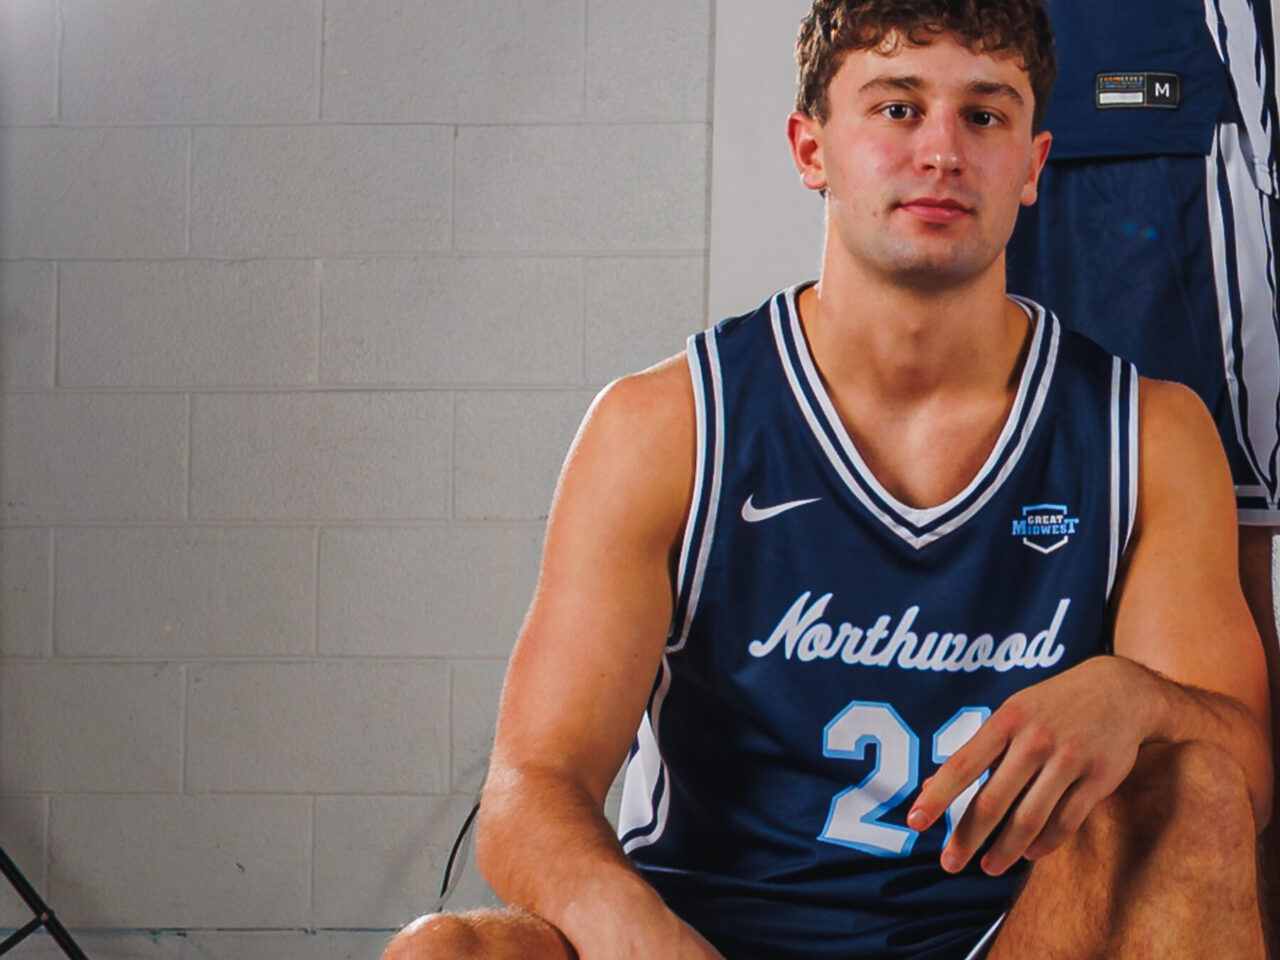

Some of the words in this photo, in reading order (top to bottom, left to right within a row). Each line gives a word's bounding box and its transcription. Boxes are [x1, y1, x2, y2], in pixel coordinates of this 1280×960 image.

[1154, 82, 1170, 98] M
[1012, 517, 1080, 536] MIDWEST
[1027, 514, 1064, 525] GREAT
[748, 590, 1071, 672] Northwood
